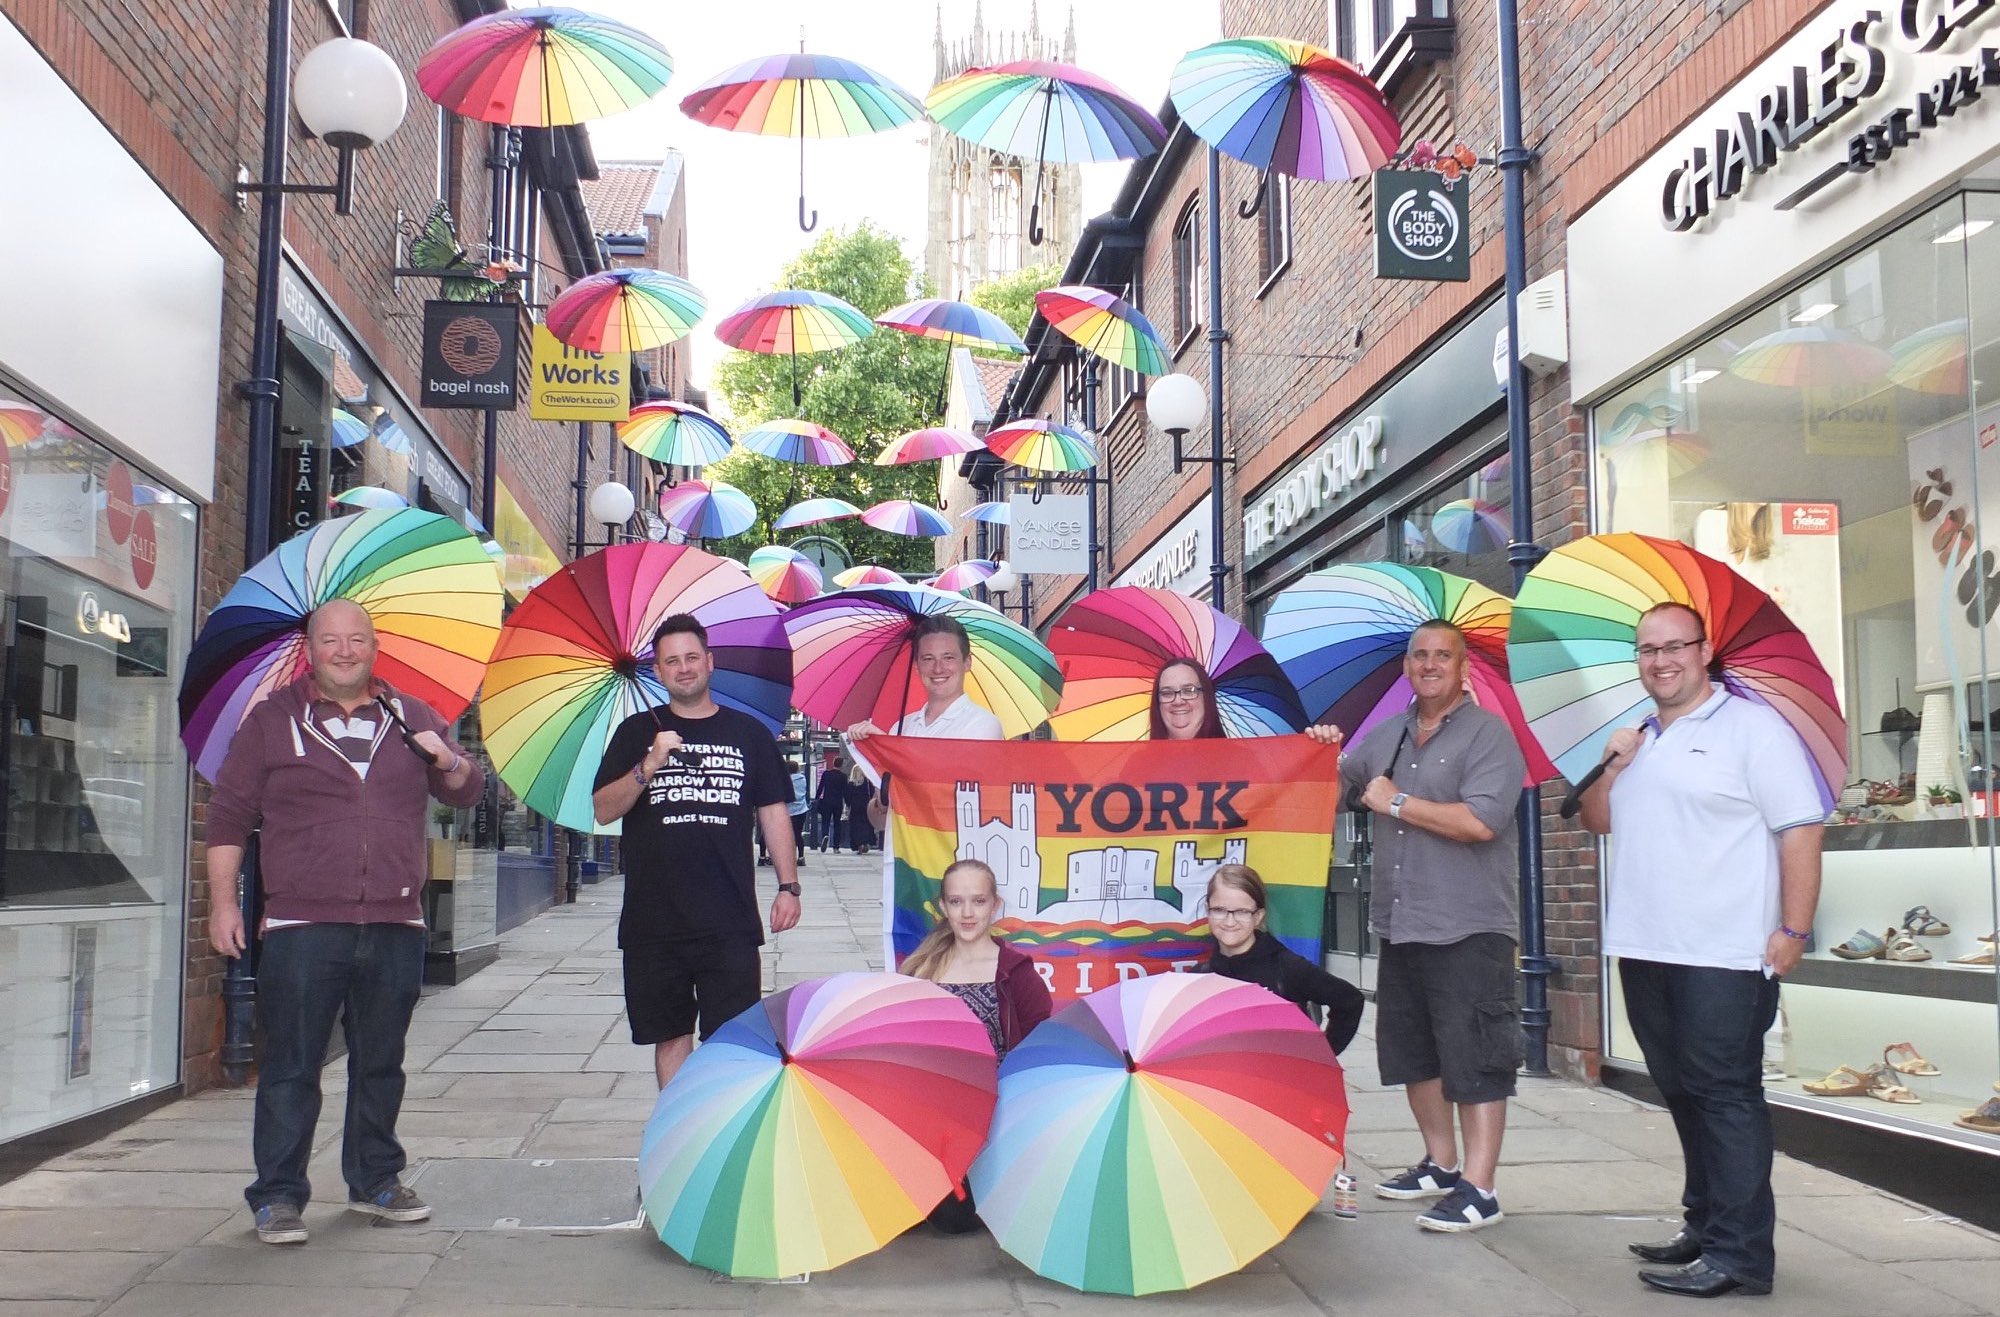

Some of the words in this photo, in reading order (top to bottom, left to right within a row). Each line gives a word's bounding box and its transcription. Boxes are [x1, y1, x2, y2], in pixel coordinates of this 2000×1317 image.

[1848, 108, 1920, 172] EST.
[1914, 48, 1996, 129] 1924
[1661, 10, 1885, 232] CHARLES
[1410, 210, 1436, 222] THE
[1402, 221, 1446, 235] BODY
[1405, 234, 1444, 247] SHOP
[283, 276, 317, 338] GREAT
[542, 363, 620, 386] Works
[430, 378, 471, 396] bagel
[474, 380, 510, 395] nash
[545, 394, 616, 405] TheWorks.co.uk
[295, 439, 313, 492] TEA
[1242, 497, 1275, 556] THE
[1274, 457, 1324, 536] BODY
[1322, 415, 1382, 500] SHOP
[131, 532, 156, 565] SALE
[680, 743, 712, 754] EVER
[711, 745, 744, 757] WILL
[649, 775, 706, 789] NARROW
[709, 776, 743, 790] VIEW
[650, 794, 666, 805] OF
[667, 787, 741, 806] GENDER
[1044, 781, 1249, 833] YORK
[663, 814, 697, 825] GRACE
